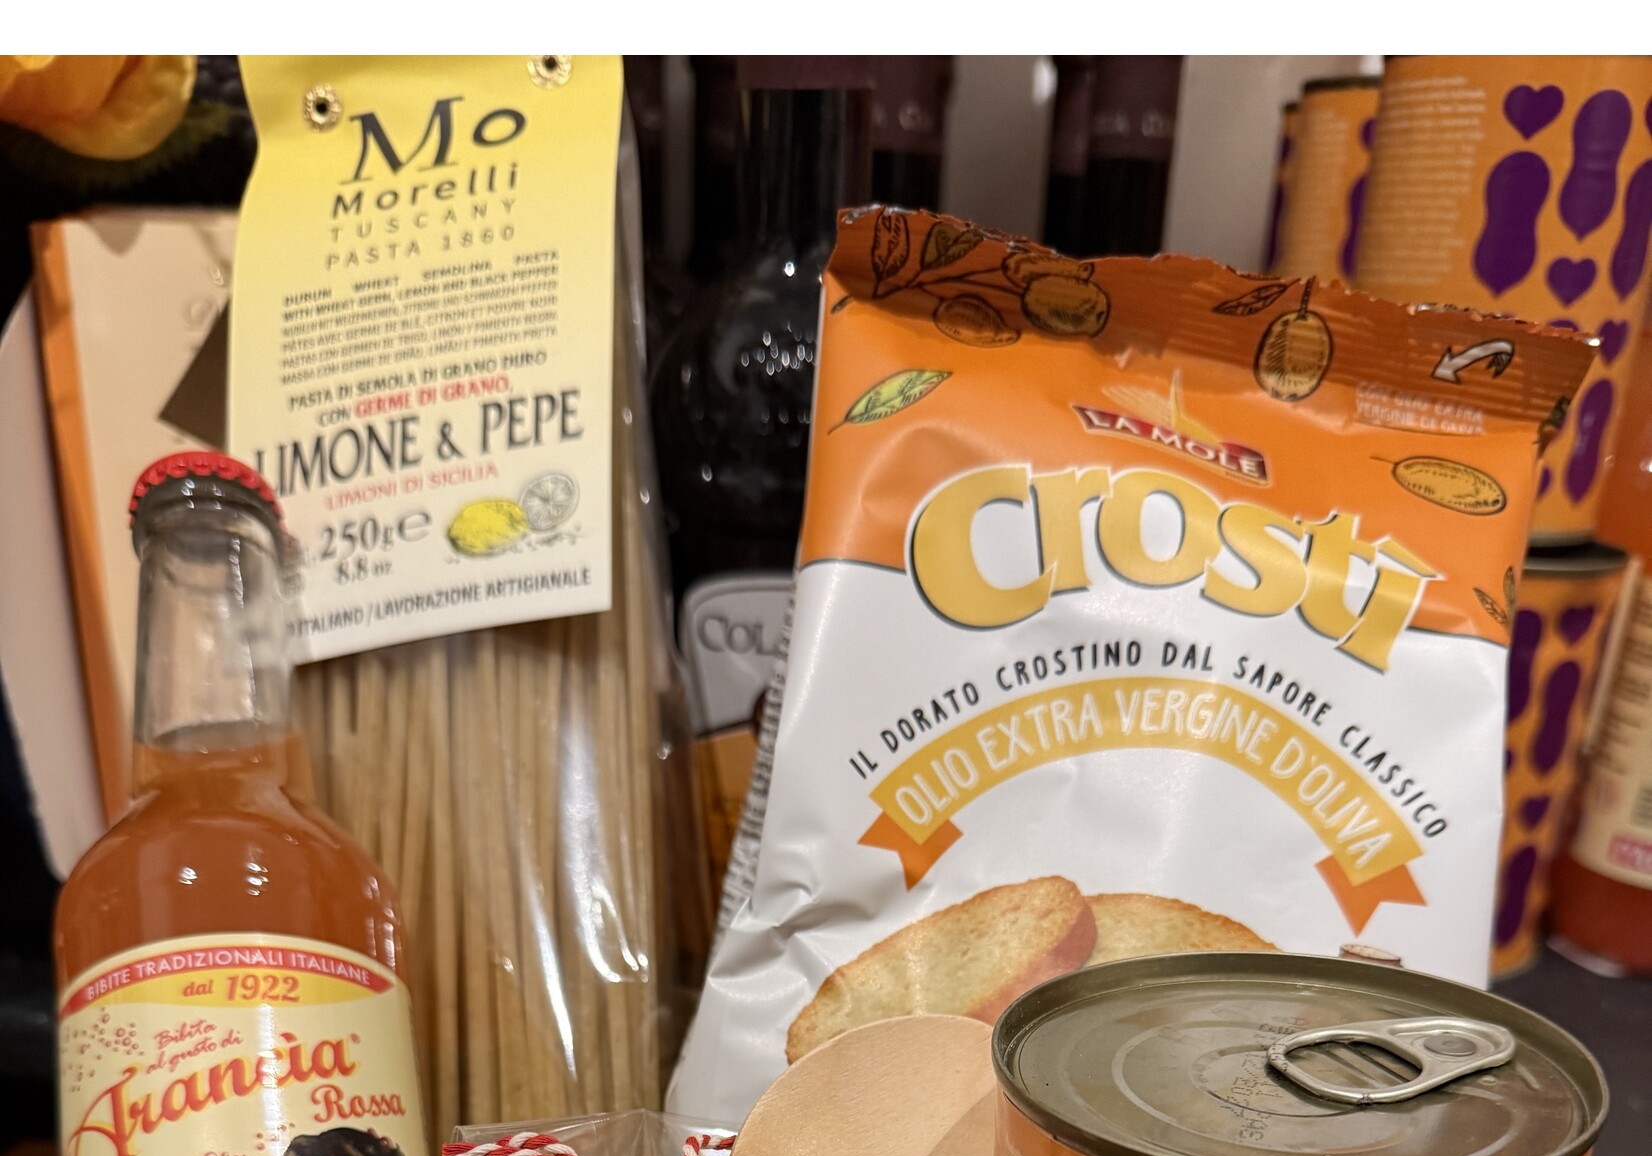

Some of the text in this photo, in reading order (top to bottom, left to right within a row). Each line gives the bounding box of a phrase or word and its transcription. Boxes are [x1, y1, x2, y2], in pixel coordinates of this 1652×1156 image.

[341, 96, 526, 185] Mo
[332, 163, 519, 220] Morelli
[331, 199, 517, 243] TUSCANY
[325, 225, 517, 271] PASTA 1860
[289, 349, 548, 411] PASTA DI SEMOLA DI GRANO DURO
[317, 406, 350, 428] CON
[354, 391, 411, 418] GERME
[416, 384, 438, 407] DI
[435, 420, 466, 461] &
[479, 388, 586, 456] PEPE
[1084, 410, 1260, 478] LA MOLE
[326, 460, 499, 511] LIMONI DI SICILIA
[485, 567, 593, 600] ARTIGIANALE
[848, 640, 1449, 838] IL DORATO CROSTINO DAL SAPORE CLASSICO
[894, 687, 1393, 868] OLIO EXTRA VERGINE D'OLIVA
[87, 949, 371, 1000] BIBITE TRADIZIONALI ITALIANE
[182, 974, 300, 1002] dal 1922
[146, 1029, 244, 1075] al gusto di
[154, 1019, 218, 1049] Bibita
[311, 1083, 407, 1123] Rossa
